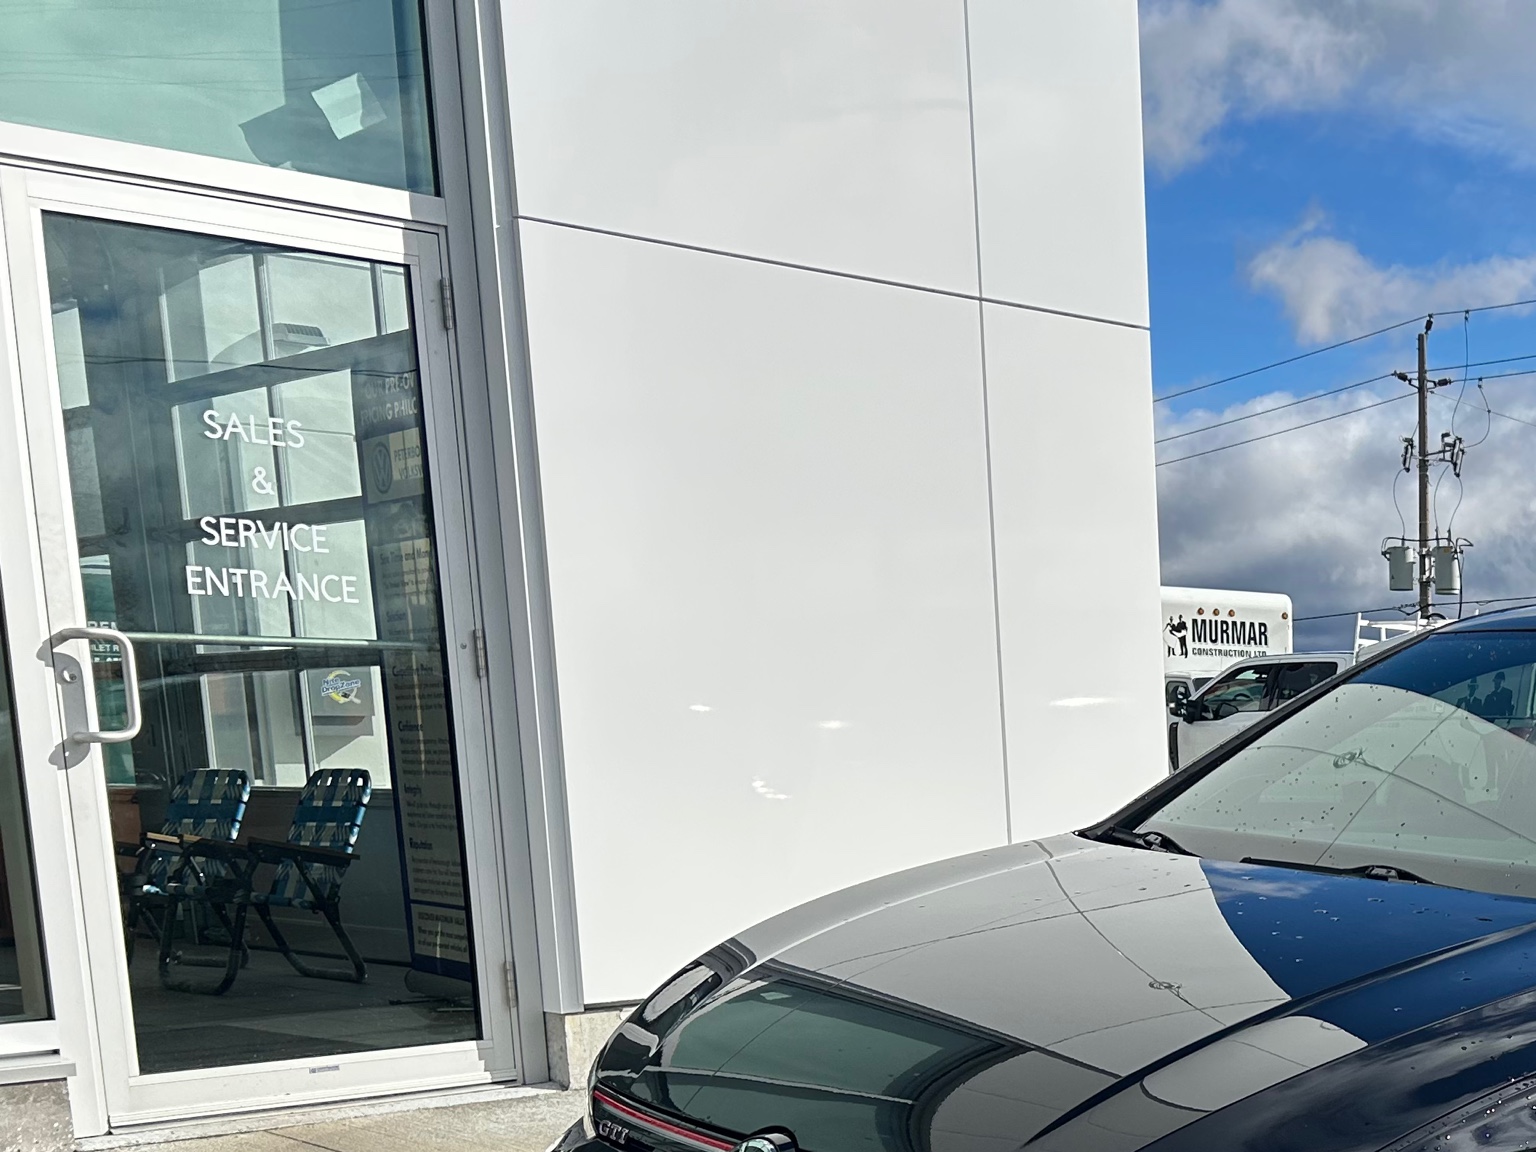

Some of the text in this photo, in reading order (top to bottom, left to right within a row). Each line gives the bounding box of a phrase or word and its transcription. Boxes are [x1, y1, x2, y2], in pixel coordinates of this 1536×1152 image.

[203, 409, 305, 448] SALES
[251, 466, 275, 496] &
[200, 516, 330, 553] SERVICE
[185, 565, 360, 604] ENTRANCE
[1191, 618, 1269, 647] MURMAR
[1192, 647, 1252, 658] CONSTRUCTION
[599, 1119, 630, 1145] GTI
